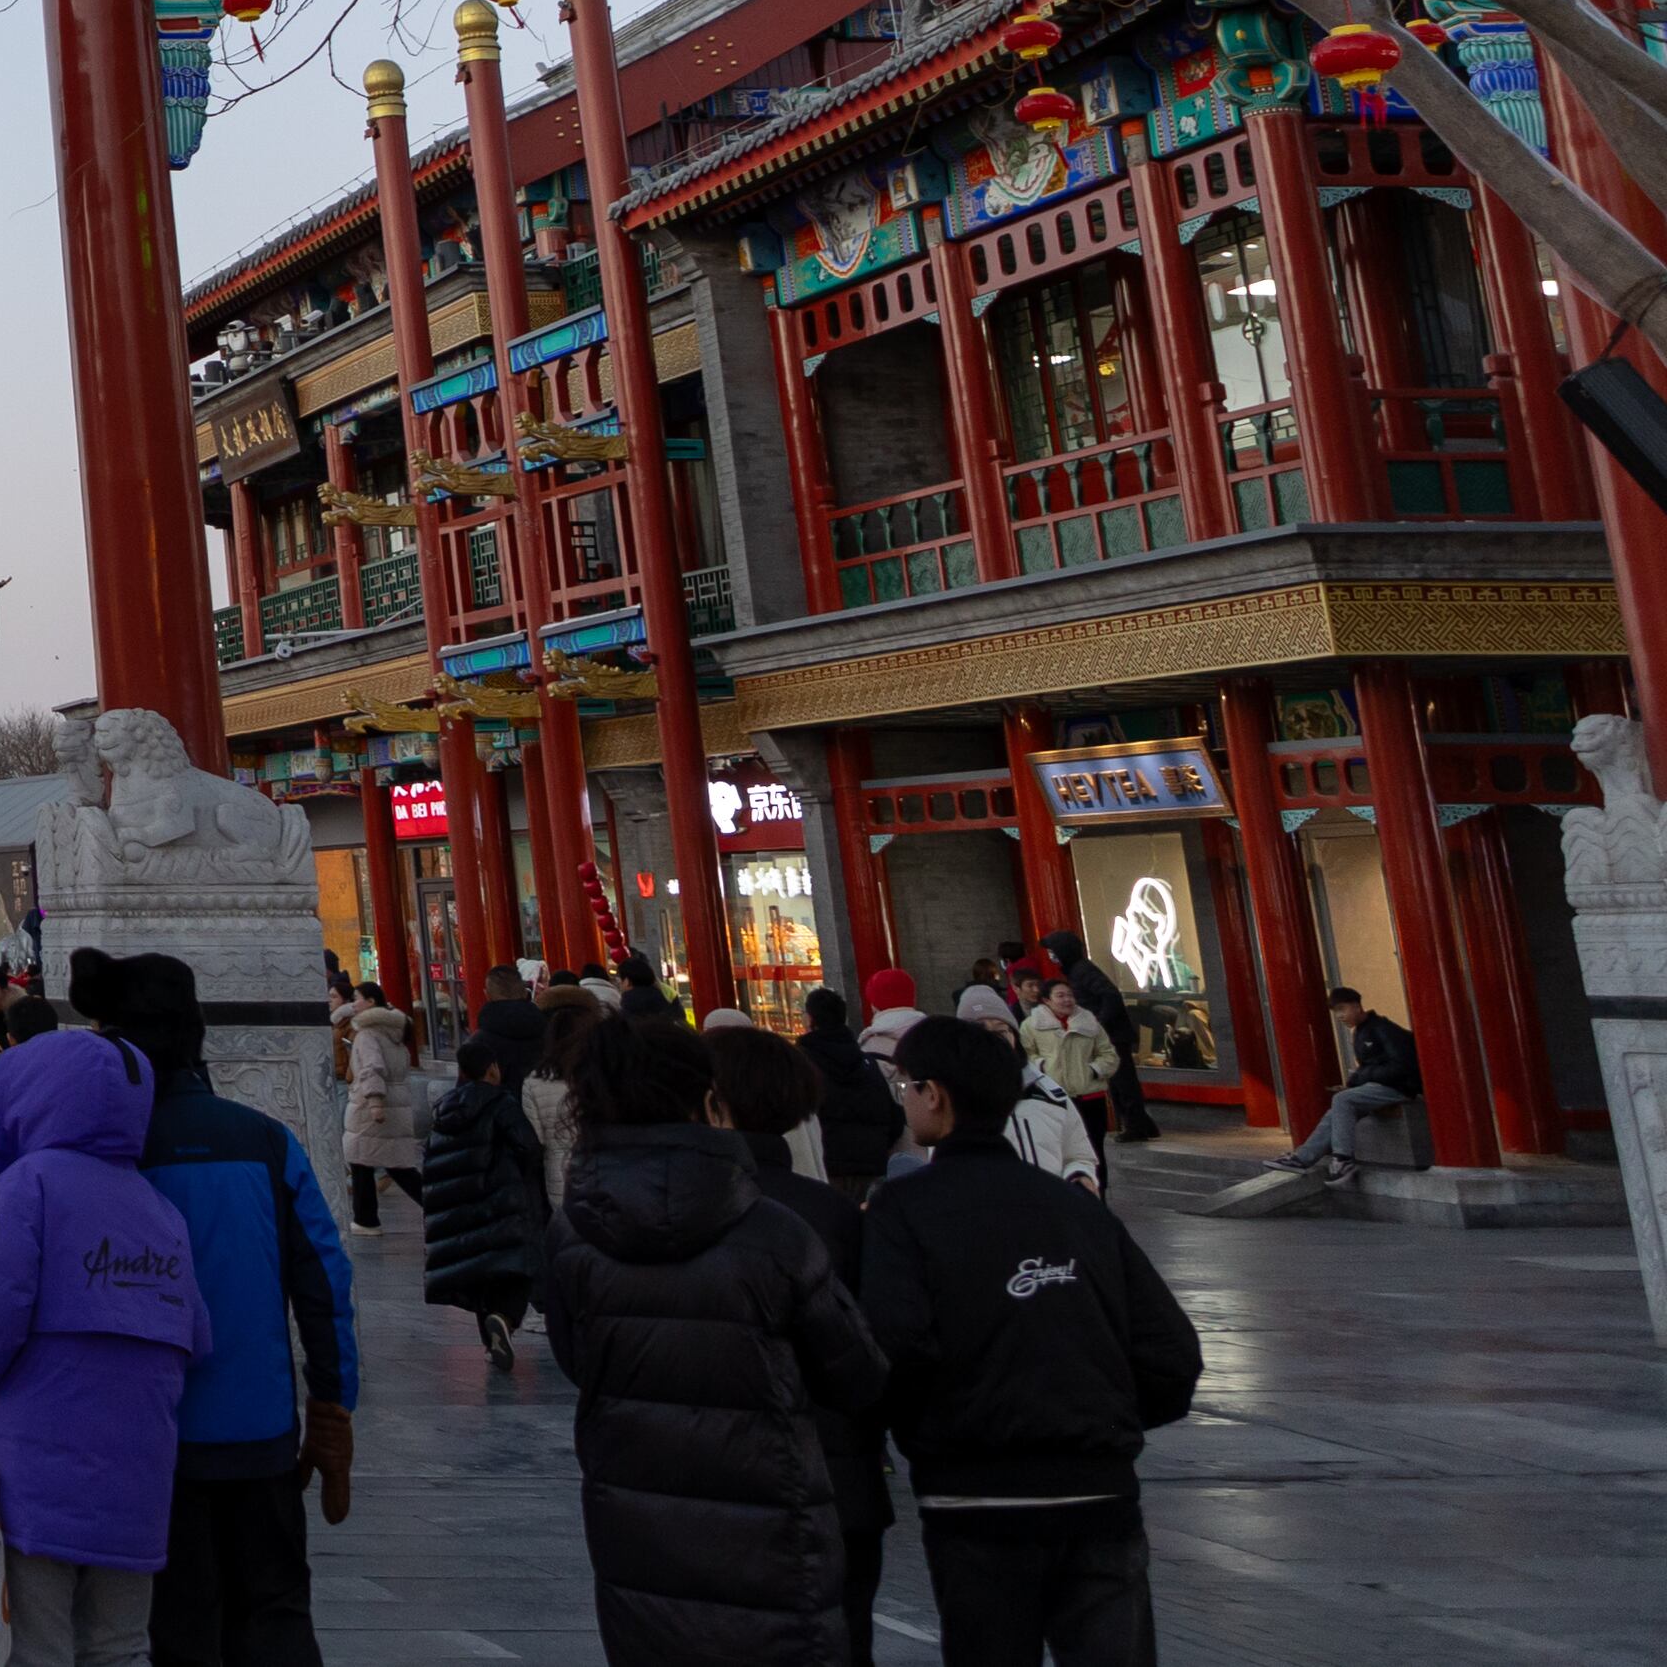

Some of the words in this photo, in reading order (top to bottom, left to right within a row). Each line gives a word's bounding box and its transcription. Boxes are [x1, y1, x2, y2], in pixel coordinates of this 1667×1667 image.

[1051, 768, 1158, 807] HEYTEA
[1159, 763, 1207, 798] 喜茶
[411, 802, 428, 819] BEI
[1006, 1255, 1078, 1298] Enjoy!
